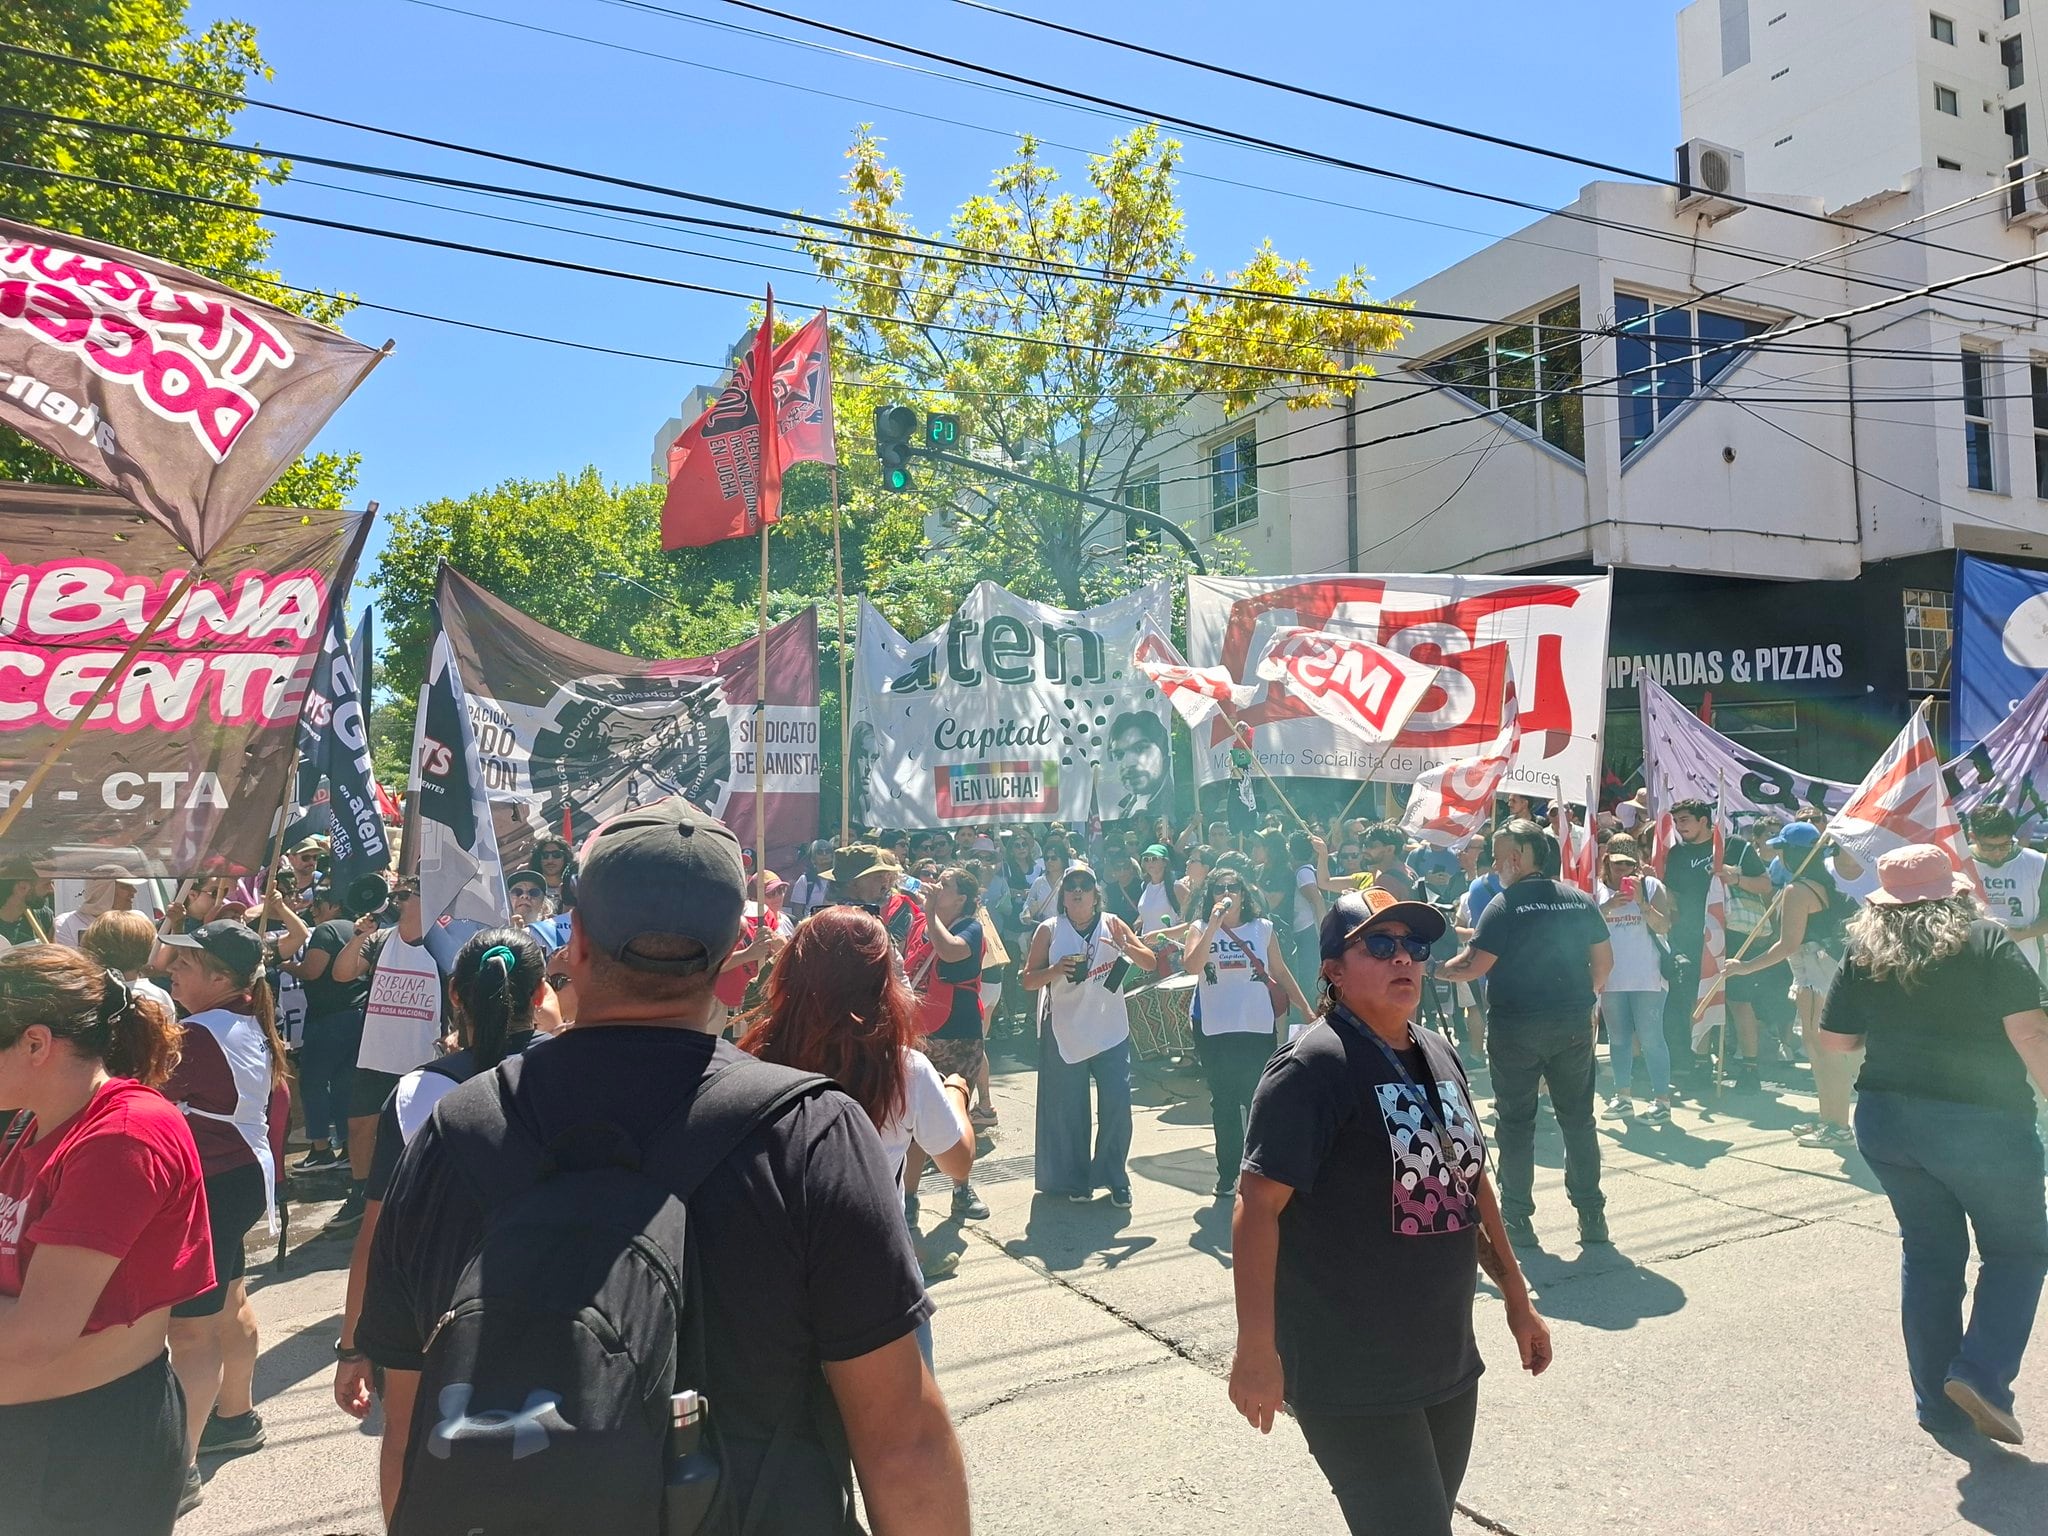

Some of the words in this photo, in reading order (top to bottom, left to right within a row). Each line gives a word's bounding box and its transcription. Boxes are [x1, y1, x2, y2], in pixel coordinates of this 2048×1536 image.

[710, 438, 728, 457] EN
[714, 453, 738, 500] LUCHA
[0, 562, 322, 641] IBUNA
[889, 609, 1107, 693] aten
[1607, 650, 1724, 689] MPANADAS
[1730, 649, 1752, 683] &
[1755, 643, 1844, 682] PIZZAS
[468, 705, 509, 727] PACIÓN
[696, 721, 708, 741] del
[934, 712, 1053, 759] Capital
[421, 737, 453, 775] TS
[735, 751, 819, 776] CEAMISTA
[1300, 749, 1384, 769] Socialista
[1390, 754, 1413, 771] de
[480, 755, 518, 792] ÓN
[101, 771, 230, 810] CTA
[421, 780, 445, 795] ENTES
[954, 778, 982, 802] ¡EN
[986, 776, 1039, 799] LUCHA!
[329, 808, 350, 843] RENTE
[339, 784, 351, 799] en
[349, 795, 383, 857] aten
[1982, 876, 2016, 890] ten
[374, 973, 426, 992] TRIBUNA
[374, 988, 435, 1008] DOCENTE
[381, 1006, 397, 1015] ROSA
[398, 1008, 430, 1020] NACIONAL
